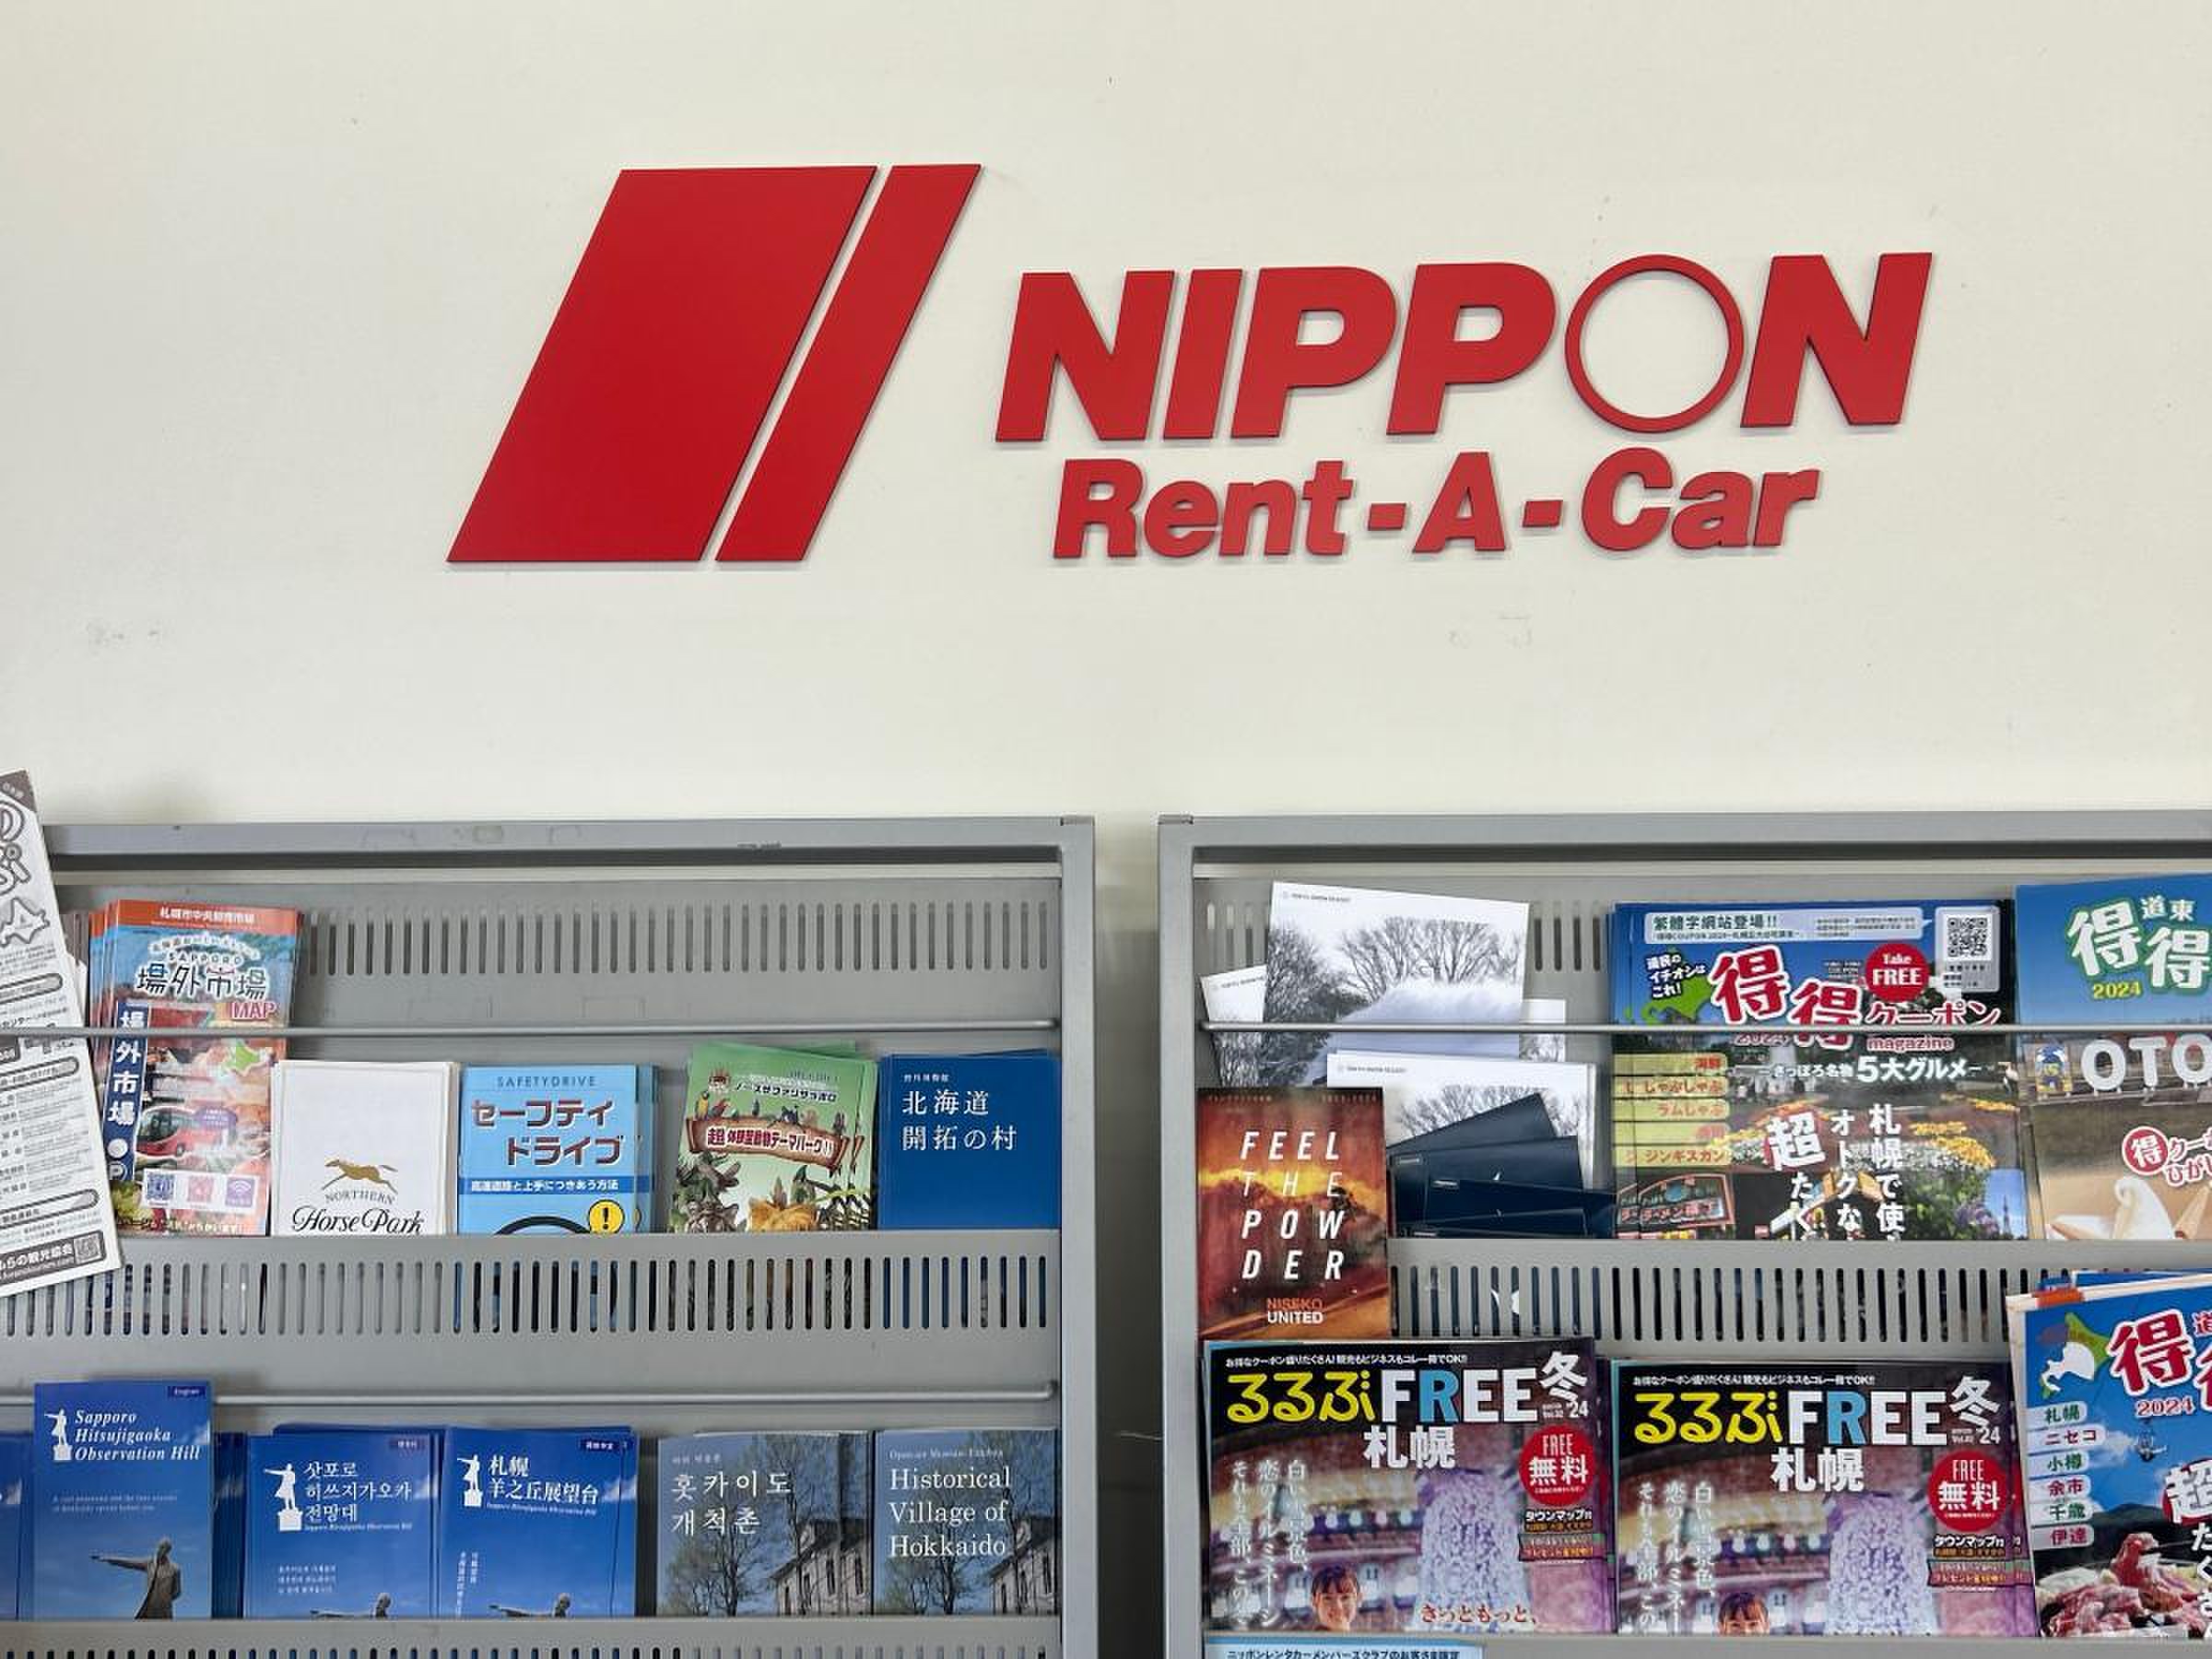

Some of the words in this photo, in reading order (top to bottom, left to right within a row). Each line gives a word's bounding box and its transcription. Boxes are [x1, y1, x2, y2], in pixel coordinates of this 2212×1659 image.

[995, 252, 1933, 443] NIPPON
[1052, 447, 1821, 560] Rent-A-Car
[2139, 894, 2195, 922] 道東
[2066, 900, 2211, 989] 得得
[169, 950, 243, 966] SAPPORO
[1882, 954, 1913, 965] Take
[136, 962, 266, 1000] 場外市場
[1872, 969, 1924, 986] FREE
[2093, 981, 2142, 1000] 2024
[231, 1002, 276, 1019] MAP
[1867, 1035, 1955, 1053] magazine
[107, 1011, 145, 1125] 場外市場
[472, 1100, 615, 1128] セーフティ
[902, 1089, 989, 1115] 北海道
[902, 1124, 1018, 1151] 開拓の村
[1240, 1131, 1340, 1160] FEEL
[507, 1135, 626, 1167] ドライブ
[1242, 1171, 1343, 1197] THE
[1830, 1109, 1863, 1240] オトクな
[1868, 1102, 1907, 1240] 札幌で使
[324, 1190, 396, 1206] NORTHERN
[292, 1206, 360, 1232] Horse
[361, 1207, 425, 1235] Park
[1241, 1209, 1346, 1240] POW
[1241, 1251, 1345, 1280] DER
[1266, 1298, 1324, 1311] NISEKO
[1266, 1311, 1325, 1324] UNITED
[2106, 1309, 2212, 1412] 得
[1539, 1350, 1588, 1402] 冬
[1227, 1370, 1376, 1424] るるぶ
[1381, 1369, 1538, 1423] FREE
[1949, 1375, 2001, 1427] 冬
[2136, 1395, 2195, 1418] 2024
[75, 1409, 137, 1427] Sapporo
[1634, 1391, 1784, 1444] るるぶ
[1788, 1390, 1947, 1445] FREE
[2044, 1403, 2080, 1424] 札幌
[75, 1428, 172, 1444] Hitsujigaoka
[1363, 1425, 1457, 1469] 札幌
[1542, 1433, 1573, 1456] FREE
[2045, 1430, 2098, 1446] ニセコ
[75, 1445, 166, 1461] Observation
[170, 1444, 201, 1461] Hill
[488, 1453, 530, 1477] 札幌
[2047, 1453, 2083, 1472] 小樽
[303, 1461, 359, 1481] 삿포로
[889, 1465, 1010, 1490] Historical
[1528, 1453, 1589, 1487] 無料
[1770, 1447, 1865, 1492] 札幌
[1952, 1459, 1984, 1481] FREE
[304, 1481, 413, 1501] 히쓰지가오카
[488, 1477, 599, 1505] 羊之丘展望台
[671, 1469, 792, 1502] 홋카이도
[1937, 1480, 2001, 1512] 無料
[2047, 1477, 2084, 1497] 余市
[304, 1503, 358, 1523] 전망대
[671, 1504, 761, 1536] 개척촌
[888, 1500, 976, 1527] Village
[984, 1499, 1009, 1522] of
[2049, 1503, 2086, 1521] 千歳
[888, 1533, 1006, 1558] Hokkaido
[2050, 1525, 2088, 1547] 伊達
